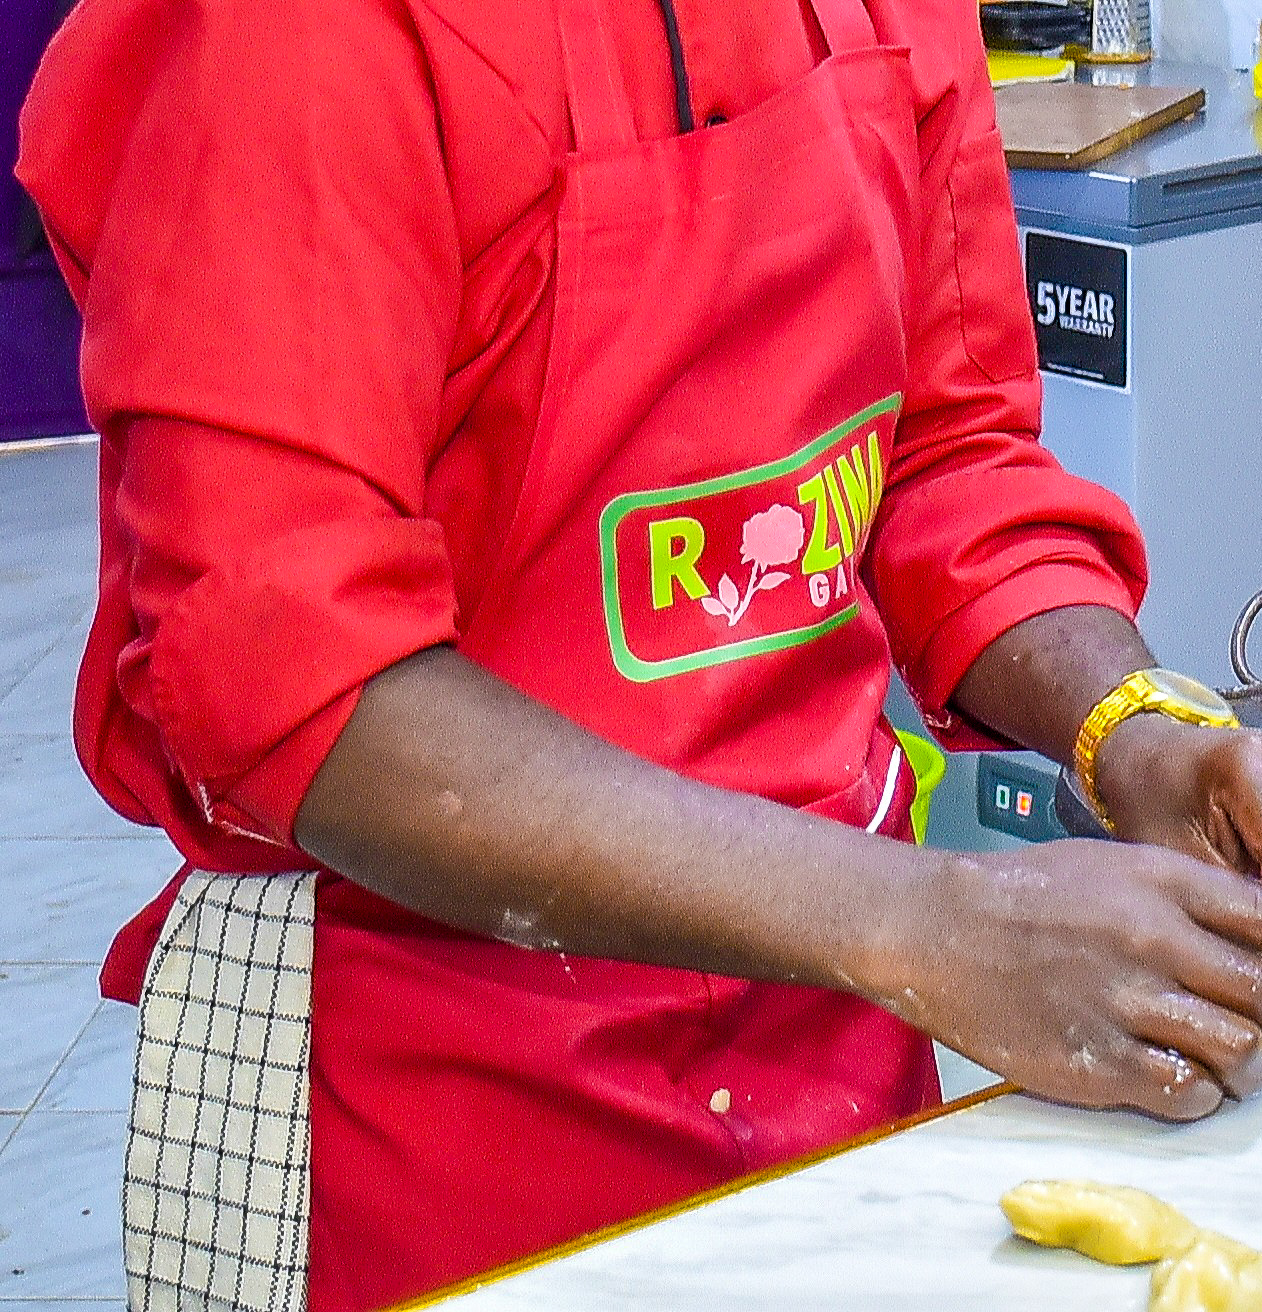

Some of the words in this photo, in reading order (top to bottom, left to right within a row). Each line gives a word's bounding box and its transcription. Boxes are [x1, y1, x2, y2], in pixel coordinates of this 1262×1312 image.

[1037, 280, 1056, 327] 5
[1056, 284, 1115, 325] YEAR
[1059, 315, 1115, 339] WARRANTY
[808, 558, 854, 608] GA
